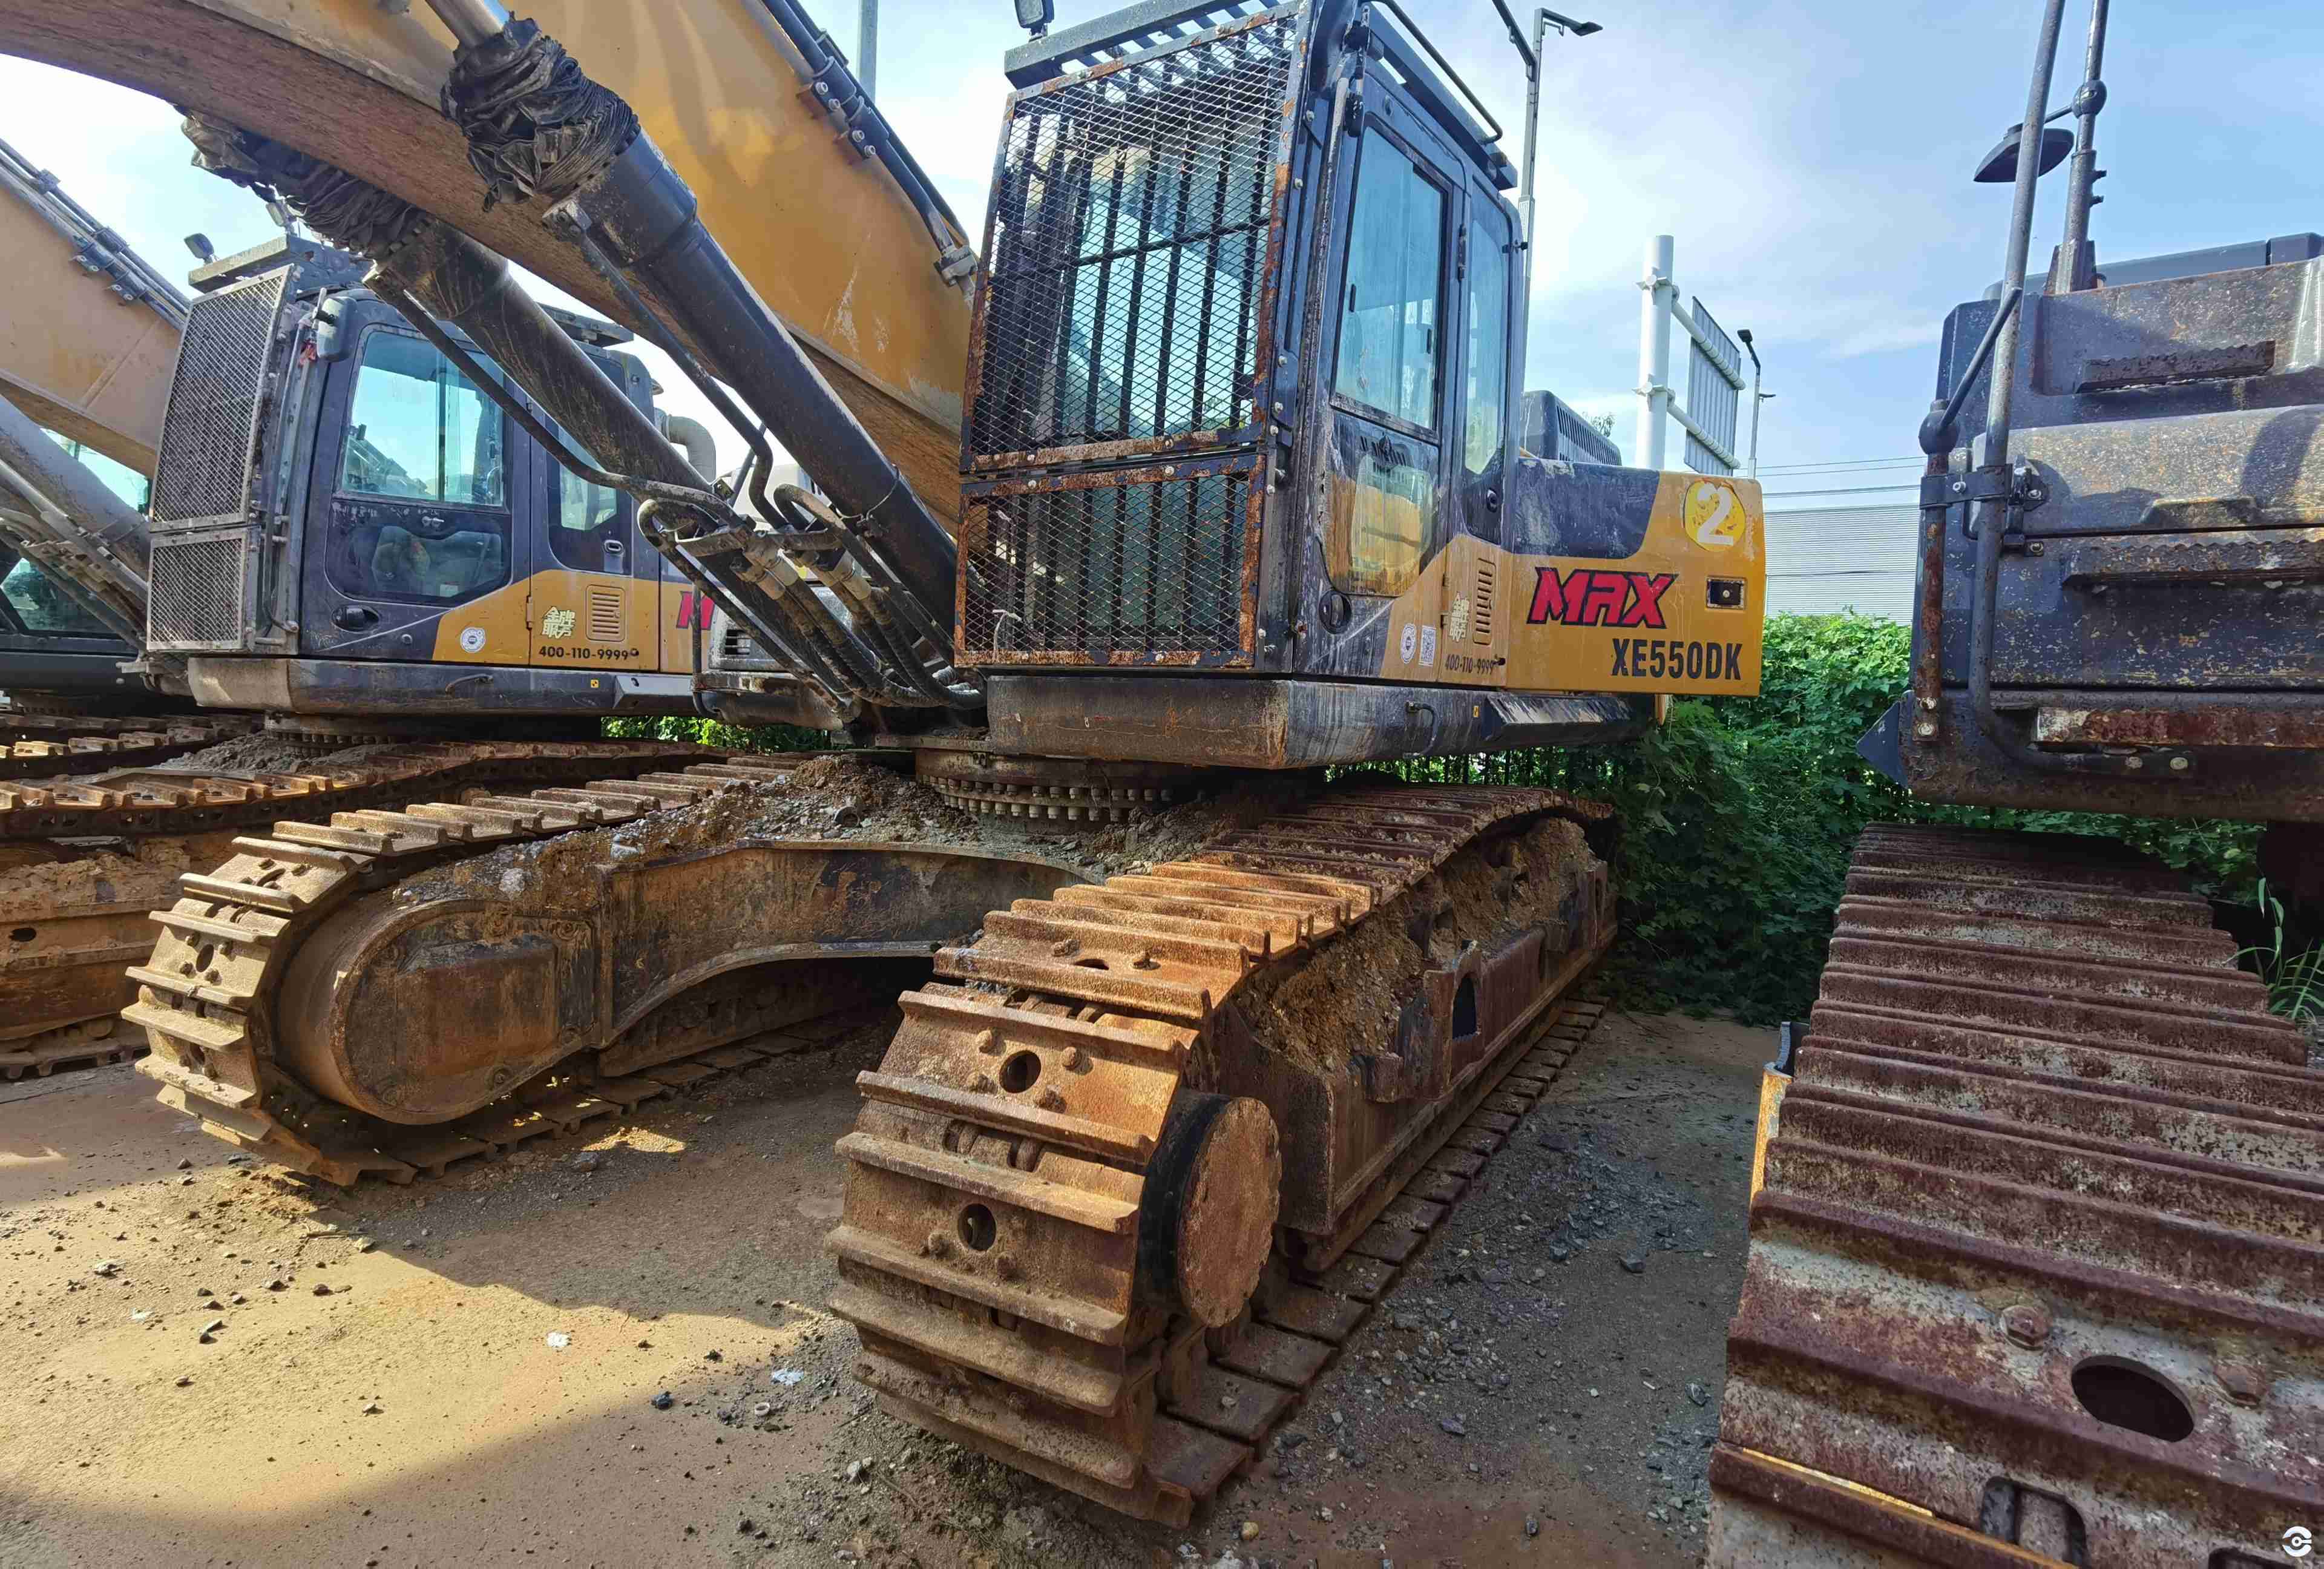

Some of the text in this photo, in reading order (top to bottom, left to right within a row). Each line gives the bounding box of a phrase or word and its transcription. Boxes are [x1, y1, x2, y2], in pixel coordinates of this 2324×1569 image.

[1697, 484, 1733, 545] 2
[1526, 567, 1679, 629] MAX
[539, 646, 628, 660] 400-110-9999
[1611, 639, 1743, 680] XE550DK
